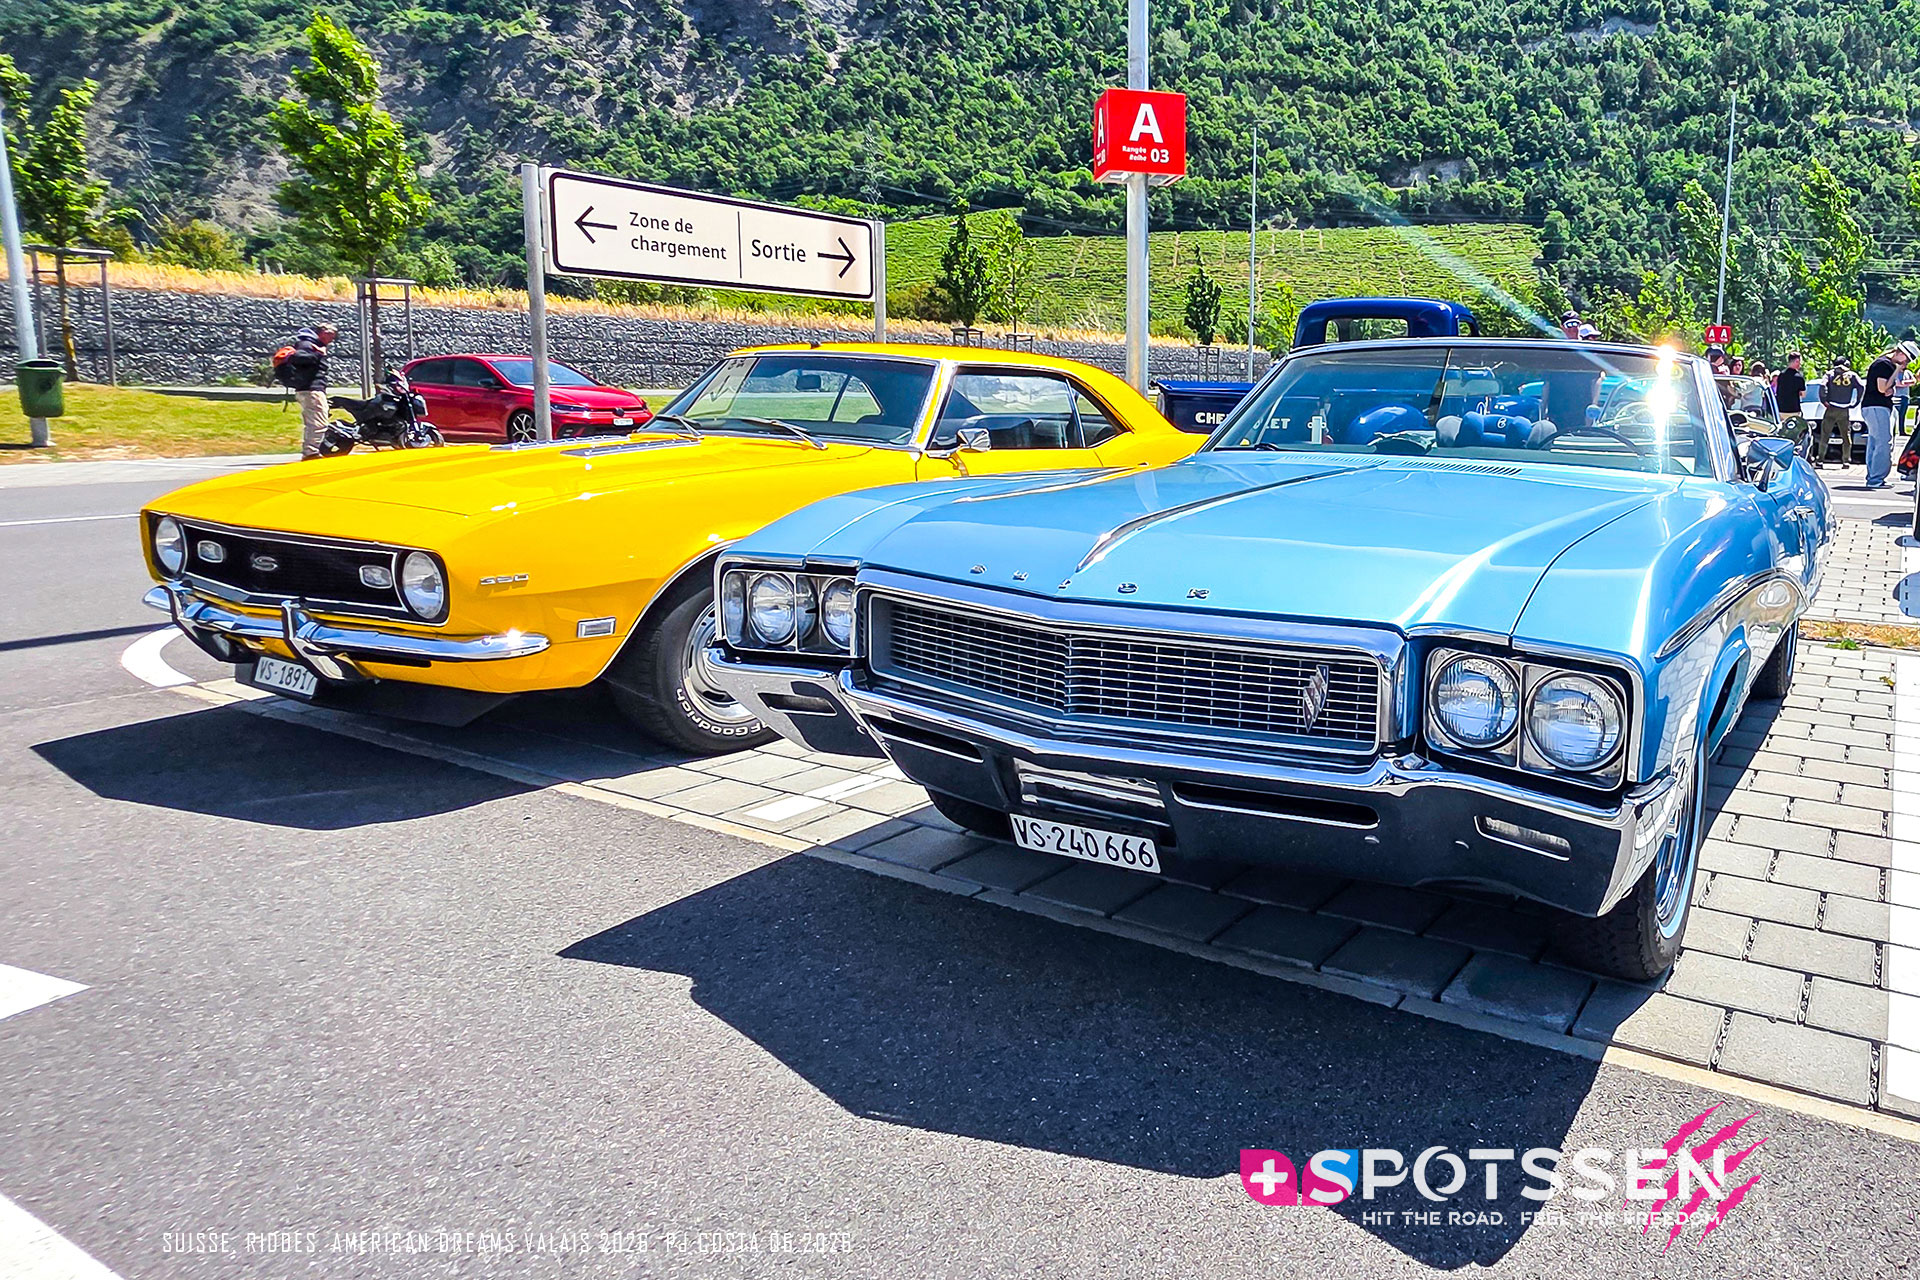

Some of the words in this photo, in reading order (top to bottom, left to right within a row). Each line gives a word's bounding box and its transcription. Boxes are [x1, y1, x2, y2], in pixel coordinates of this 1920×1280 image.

[1097, 107, 1105, 148] A
[1129, 103, 1164, 143] A
[1150, 148, 1170, 163] 03
[629, 211, 670, 231] Zone
[674, 217, 694, 234] de
[631, 235, 727, 260] chargement
[751, 239, 807, 263] Sortie
[1105, 835, 1154, 868] 666
